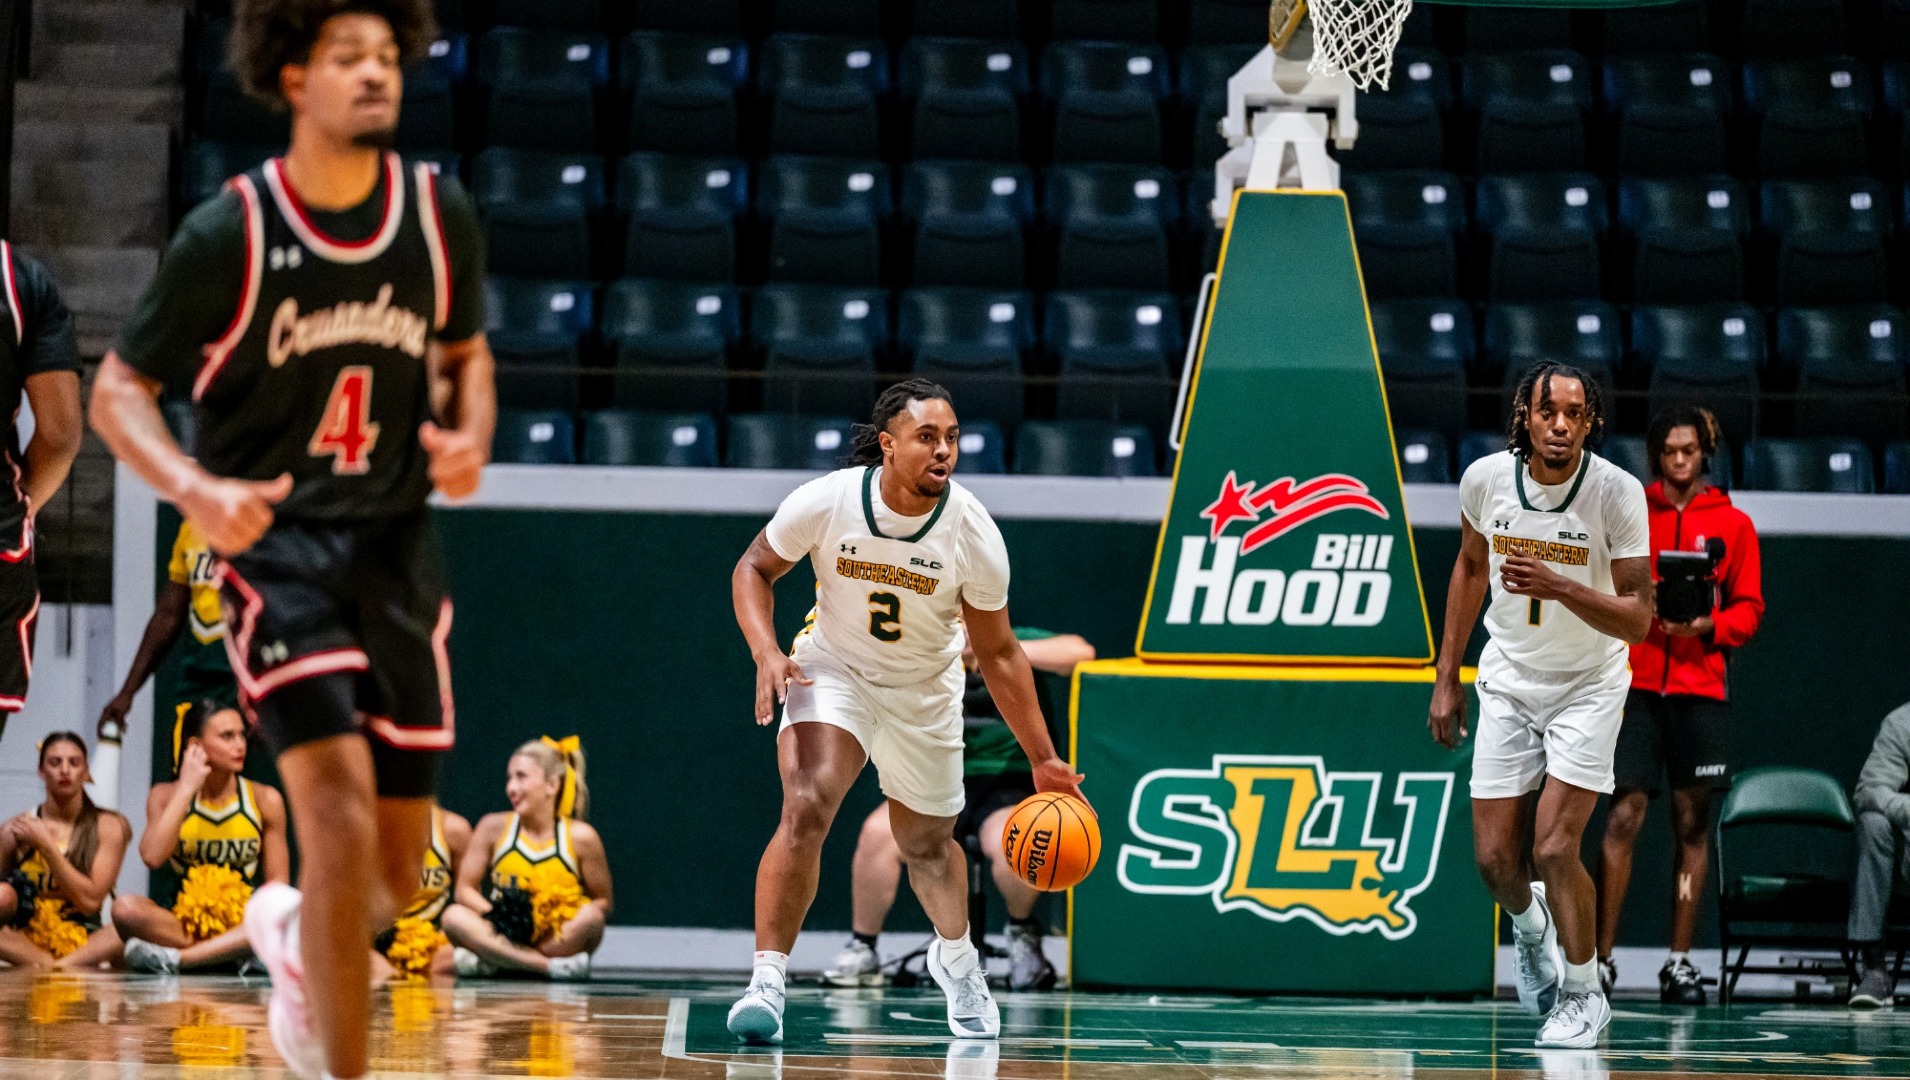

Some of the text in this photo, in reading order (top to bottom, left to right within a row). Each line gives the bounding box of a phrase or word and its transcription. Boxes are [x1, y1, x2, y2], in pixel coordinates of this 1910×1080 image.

[308, 365, 381, 476] 4
[1311, 534, 1394, 569] Bill
[1557, 531, 1589, 540] SLC
[836, 556, 939, 596] SOUTHEASTERN
[909, 557, 943, 570] SLC
[867, 589, 902, 643] 2
[1026, 829, 1053, 886] Wilson
